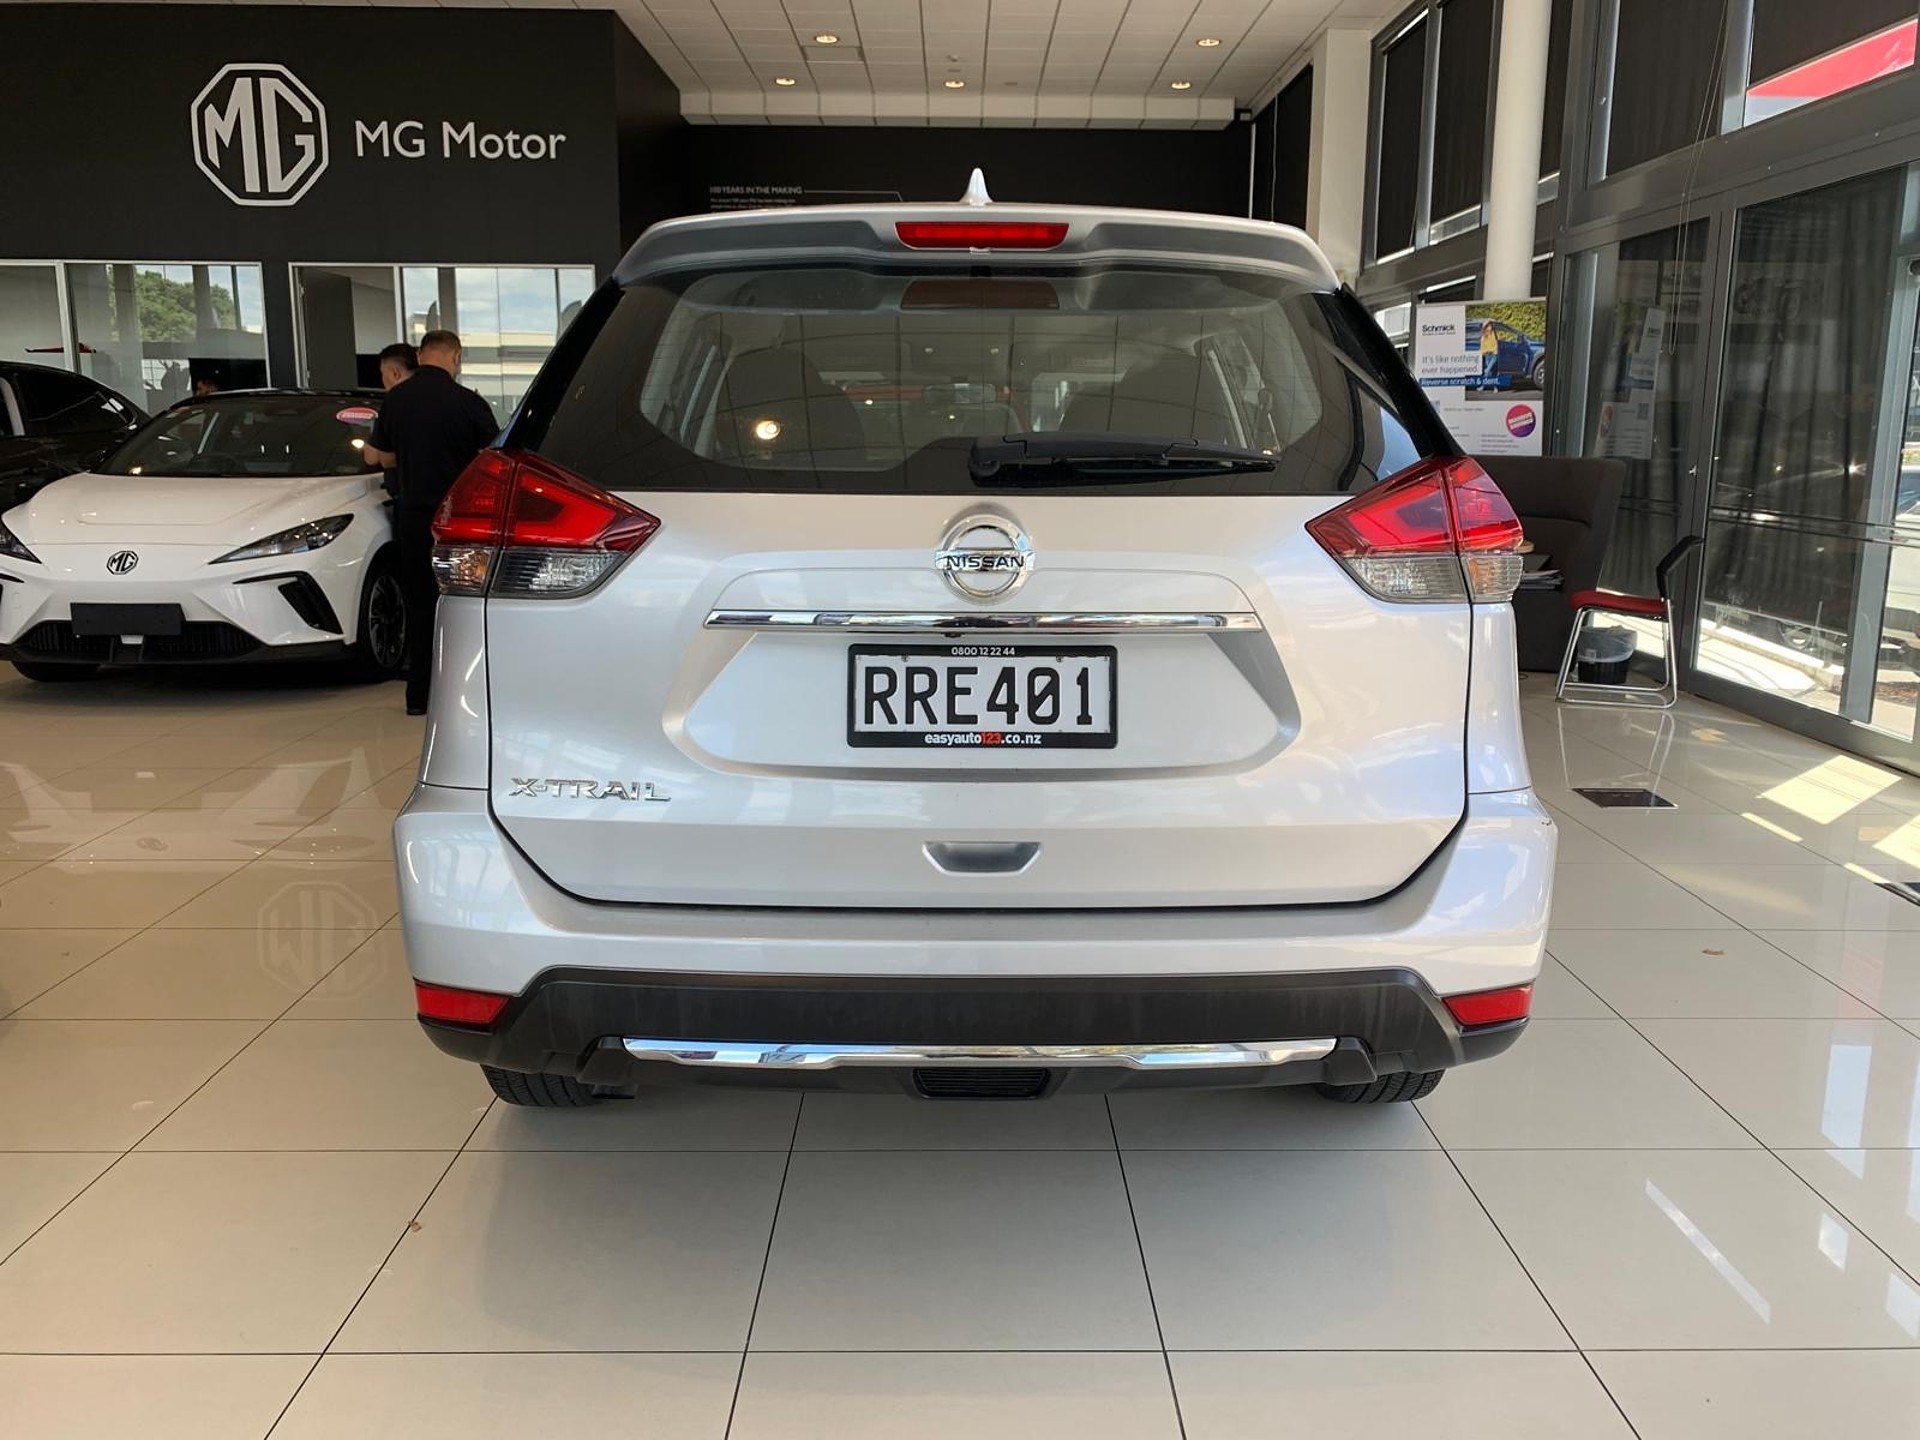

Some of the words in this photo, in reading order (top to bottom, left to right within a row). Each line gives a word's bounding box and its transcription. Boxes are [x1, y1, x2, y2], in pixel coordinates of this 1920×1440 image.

[203, 76, 316, 193] MG
[355, 120, 426, 158] MG
[442, 120, 567, 160] Motor
[1422, 324, 1455, 333] Schmick
[1422, 355, 1434, 364] It's
[1435, 355, 1449, 364] like
[1450, 354, 1480, 364] nothing
[1421, 366, 1438, 374] ever
[1440, 365, 1478, 375] happened.
[109, 552, 136, 572] MG
[946, 555, 1025, 569] NISSAN
[951, 646, 978, 656] 0800
[979, 646, 990, 656] 12
[990, 646, 1002, 656] 22
[1003, 646, 1016, 656] 44
[864, 666, 1093, 726] RRE401
[924, 731, 1042, 747] easyauto123.co.nz
[509, 777, 672, 802] X-TRAIL
